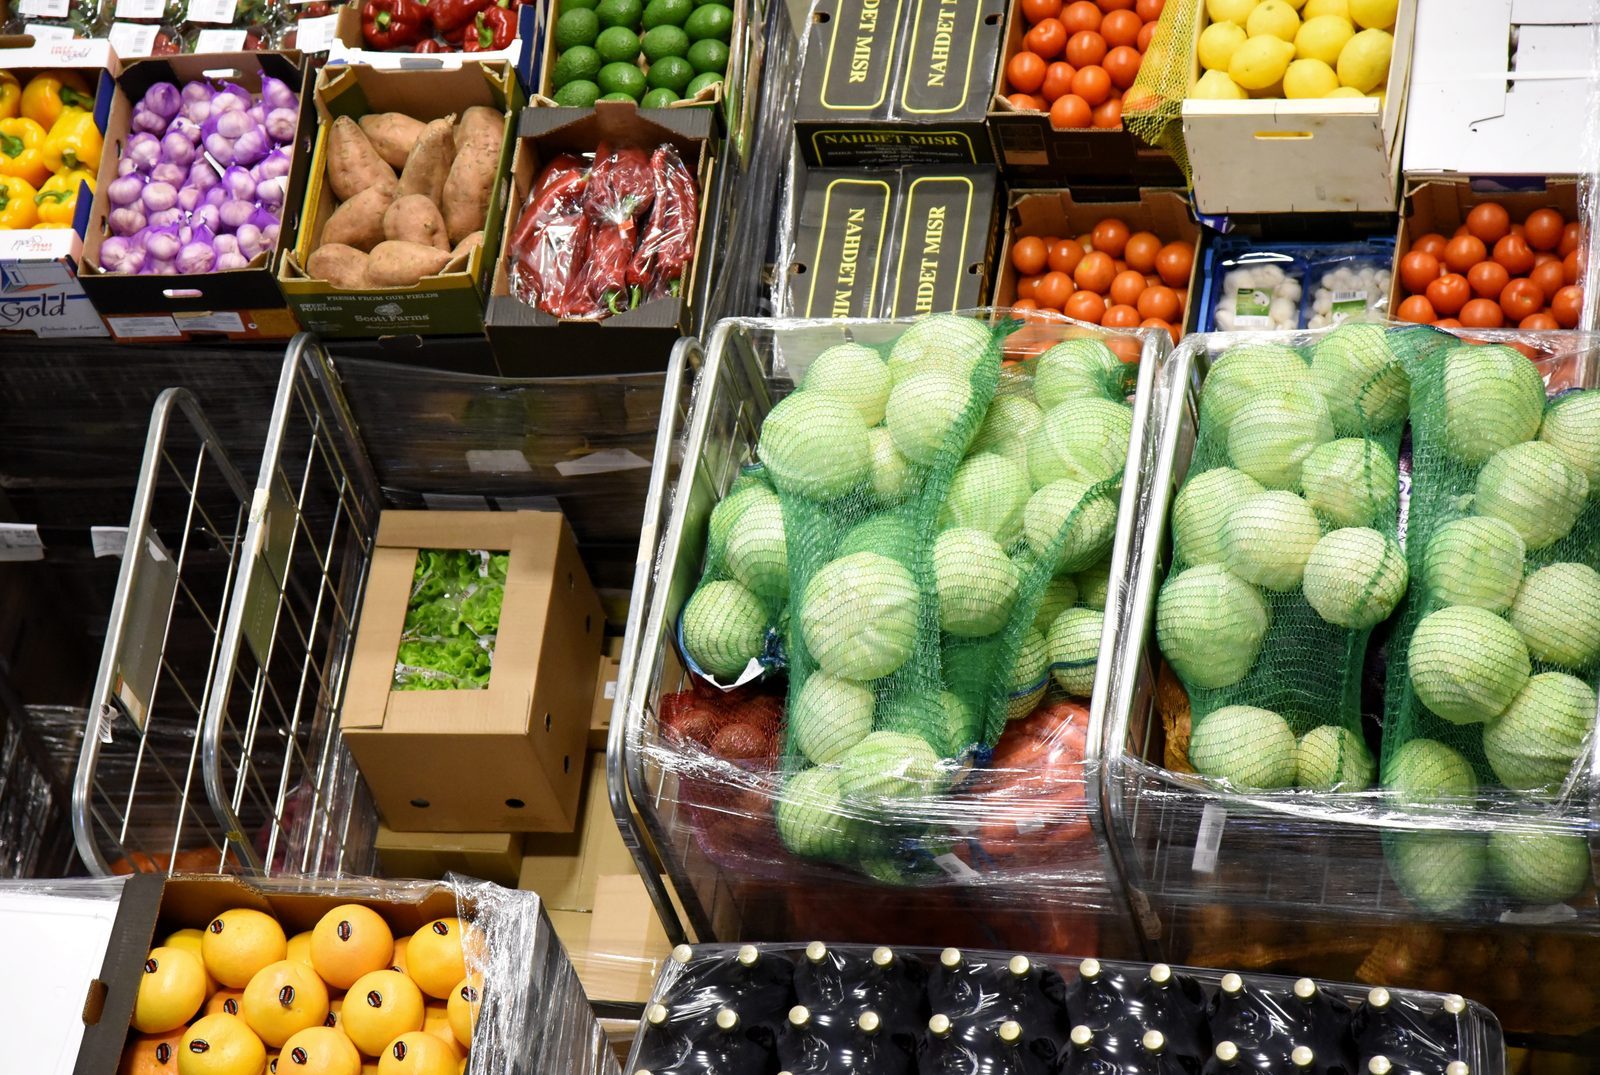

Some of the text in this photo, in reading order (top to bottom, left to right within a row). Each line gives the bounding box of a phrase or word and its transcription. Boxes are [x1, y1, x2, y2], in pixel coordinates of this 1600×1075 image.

[849, 36, 874, 84] MISR
[927, 9, 956, 87] NAHDET
[824, 134, 959, 146] NAHDET MISR
[838, 208, 866, 286] NAHDET
[923, 205, 946, 254] MISR
[0, 292, 65, 328] Gold
[354, 314, 430, 322] Scott Farms
